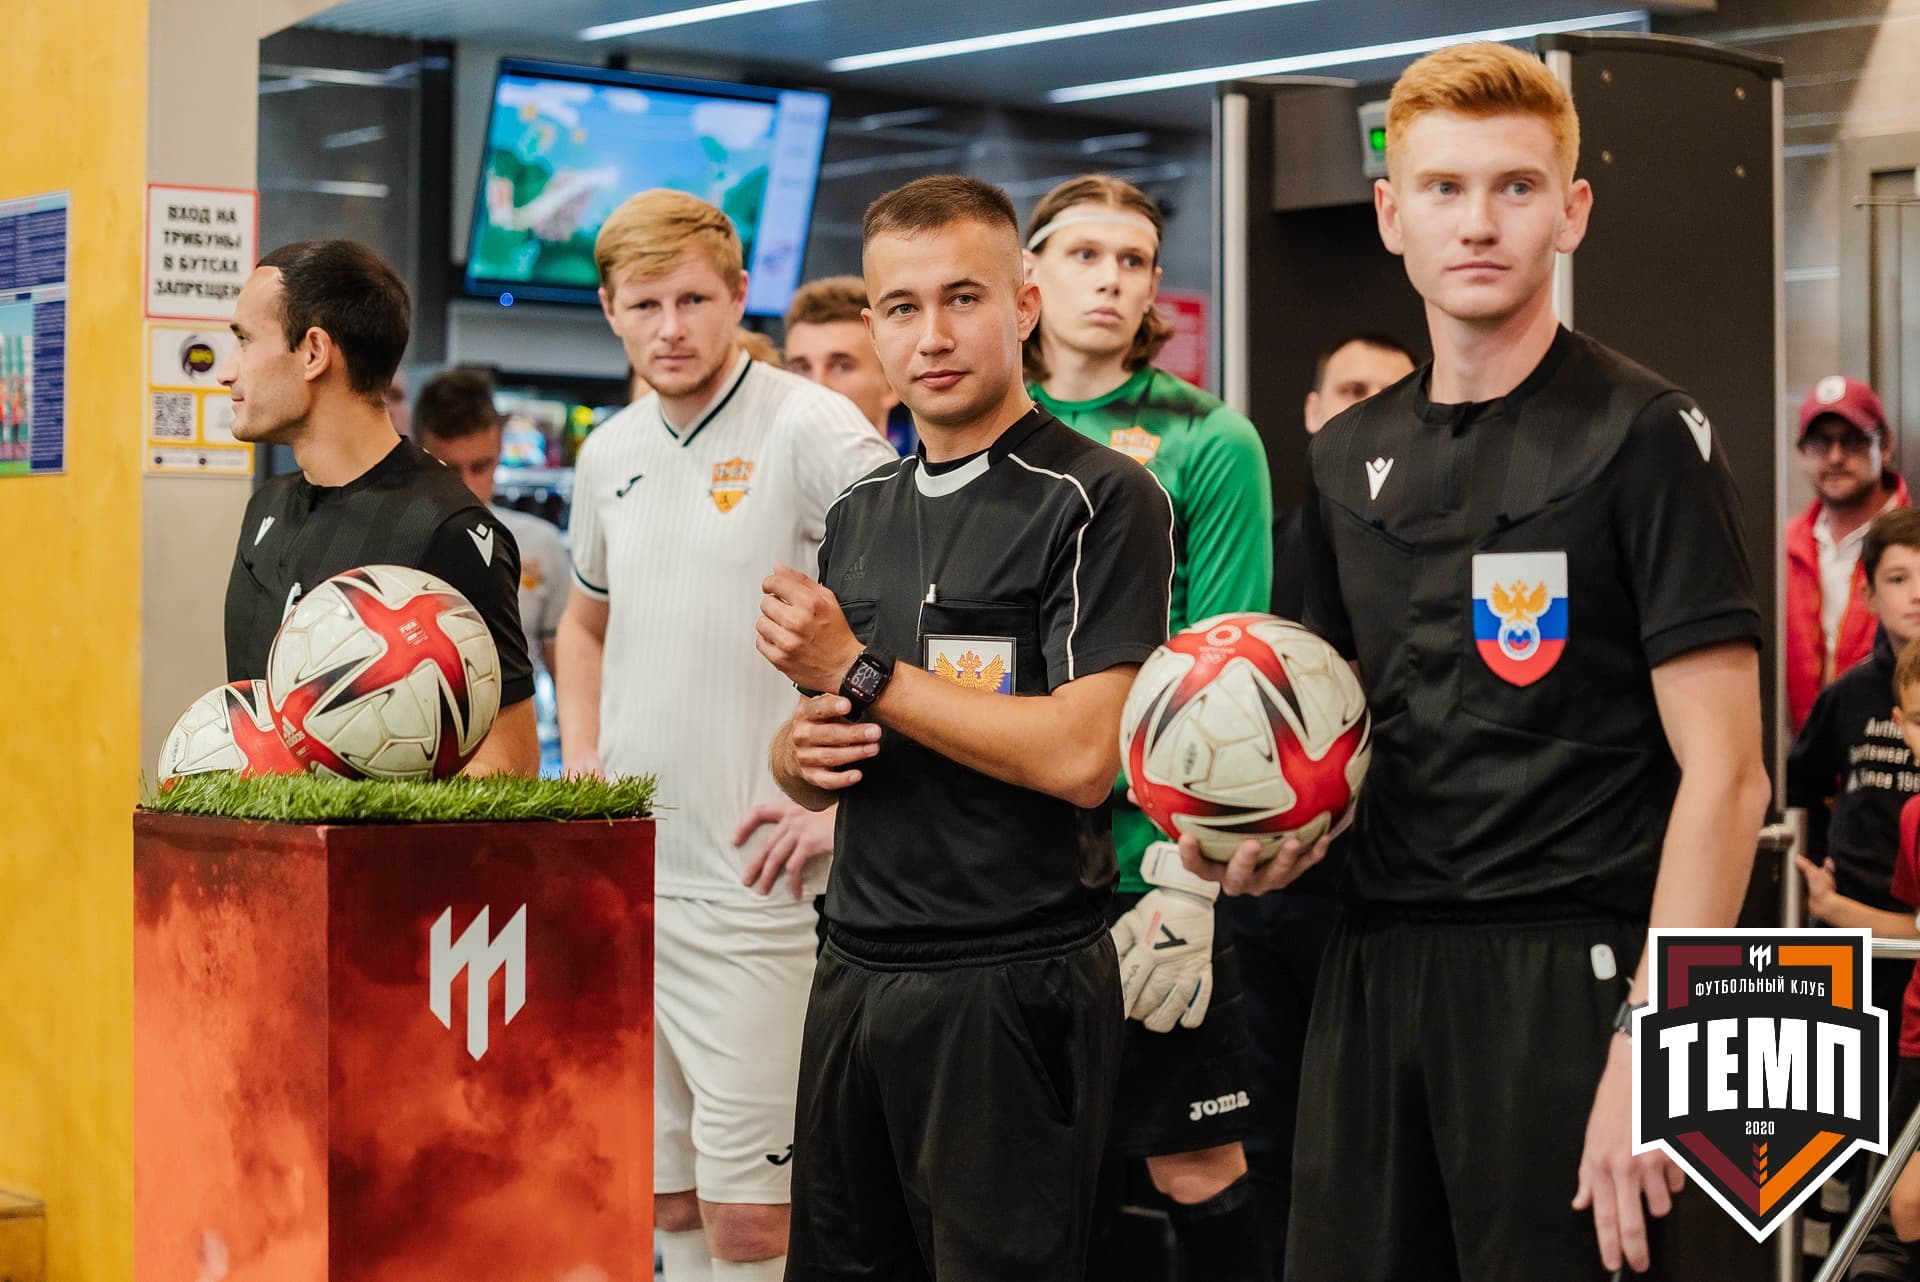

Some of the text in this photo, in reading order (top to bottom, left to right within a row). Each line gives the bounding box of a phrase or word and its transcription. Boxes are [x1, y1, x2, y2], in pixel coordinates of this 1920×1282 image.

[167, 205, 236, 223] ВХОД НА
[163, 230, 242, 248] ТРИБУНЫ
[164, 255, 239, 273] В БУТСАХ
[1864, 717, 1904, 740] Authe
